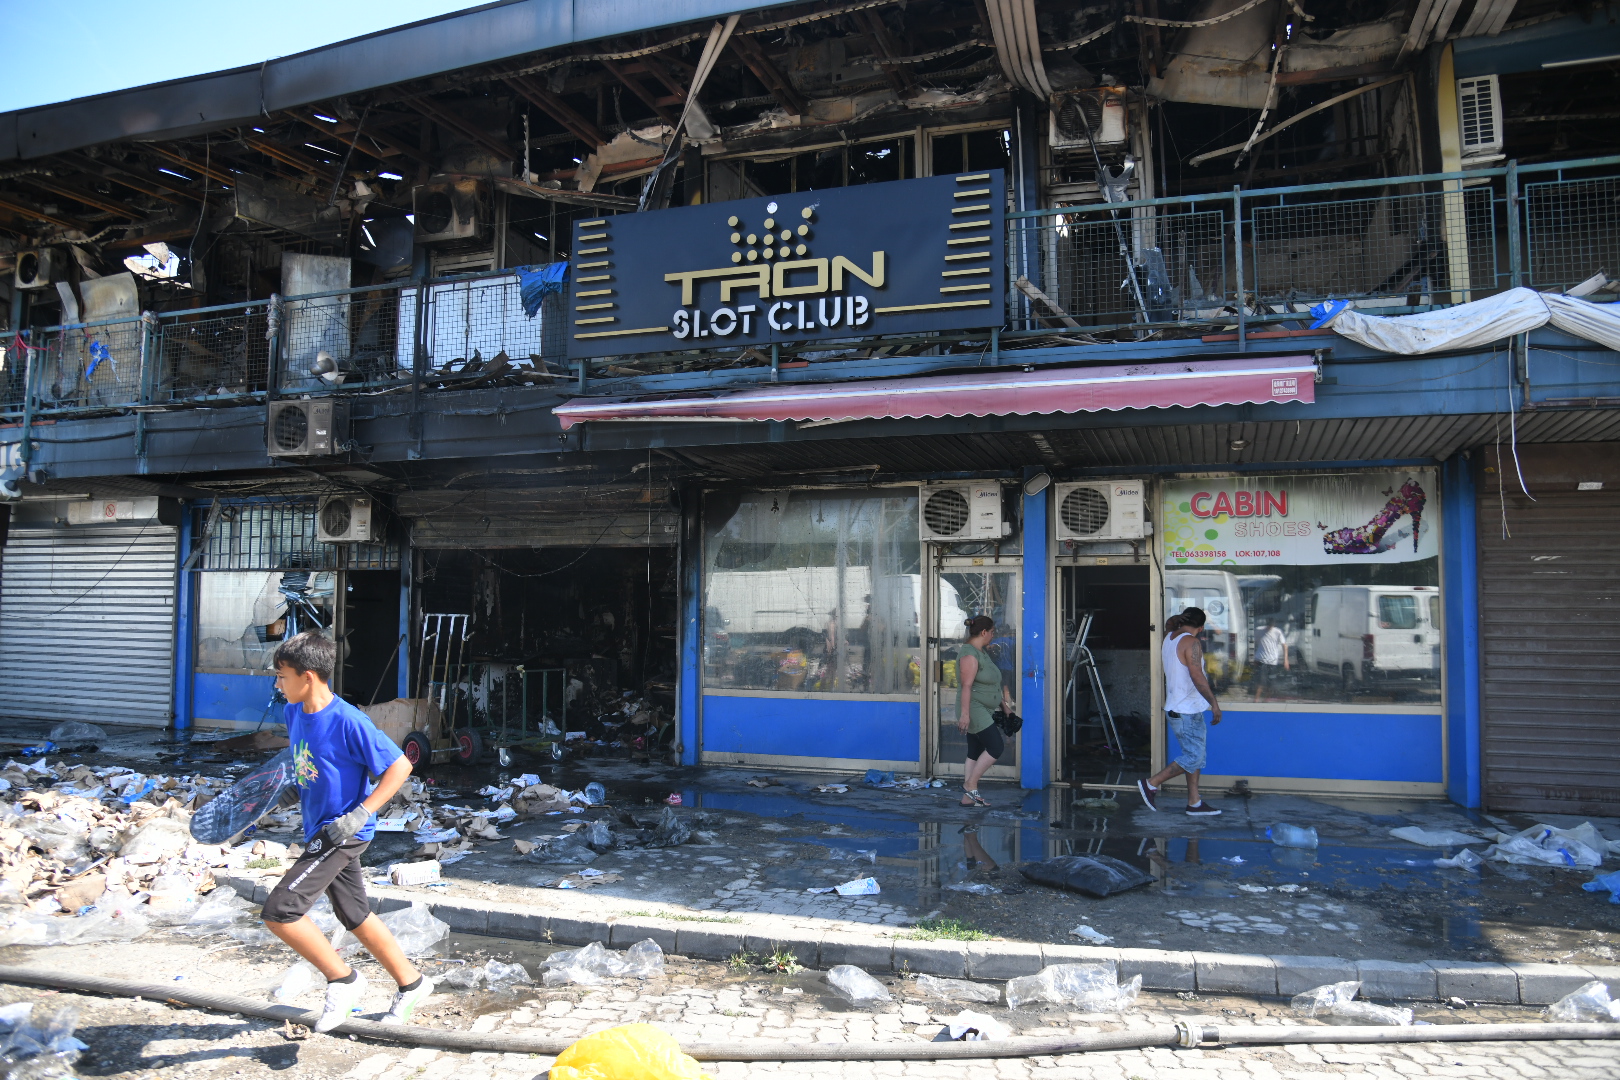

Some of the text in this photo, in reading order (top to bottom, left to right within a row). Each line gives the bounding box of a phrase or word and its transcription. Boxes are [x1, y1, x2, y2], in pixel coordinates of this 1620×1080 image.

[664, 250, 885, 306] TRON
[672, 295, 870, 339] SLOT CLUB
[1189, 490, 1288, 518] CABIN
[1234, 521, 1312, 538] SHOES
[1235, 550, 1281, 559] LOK:107,108
